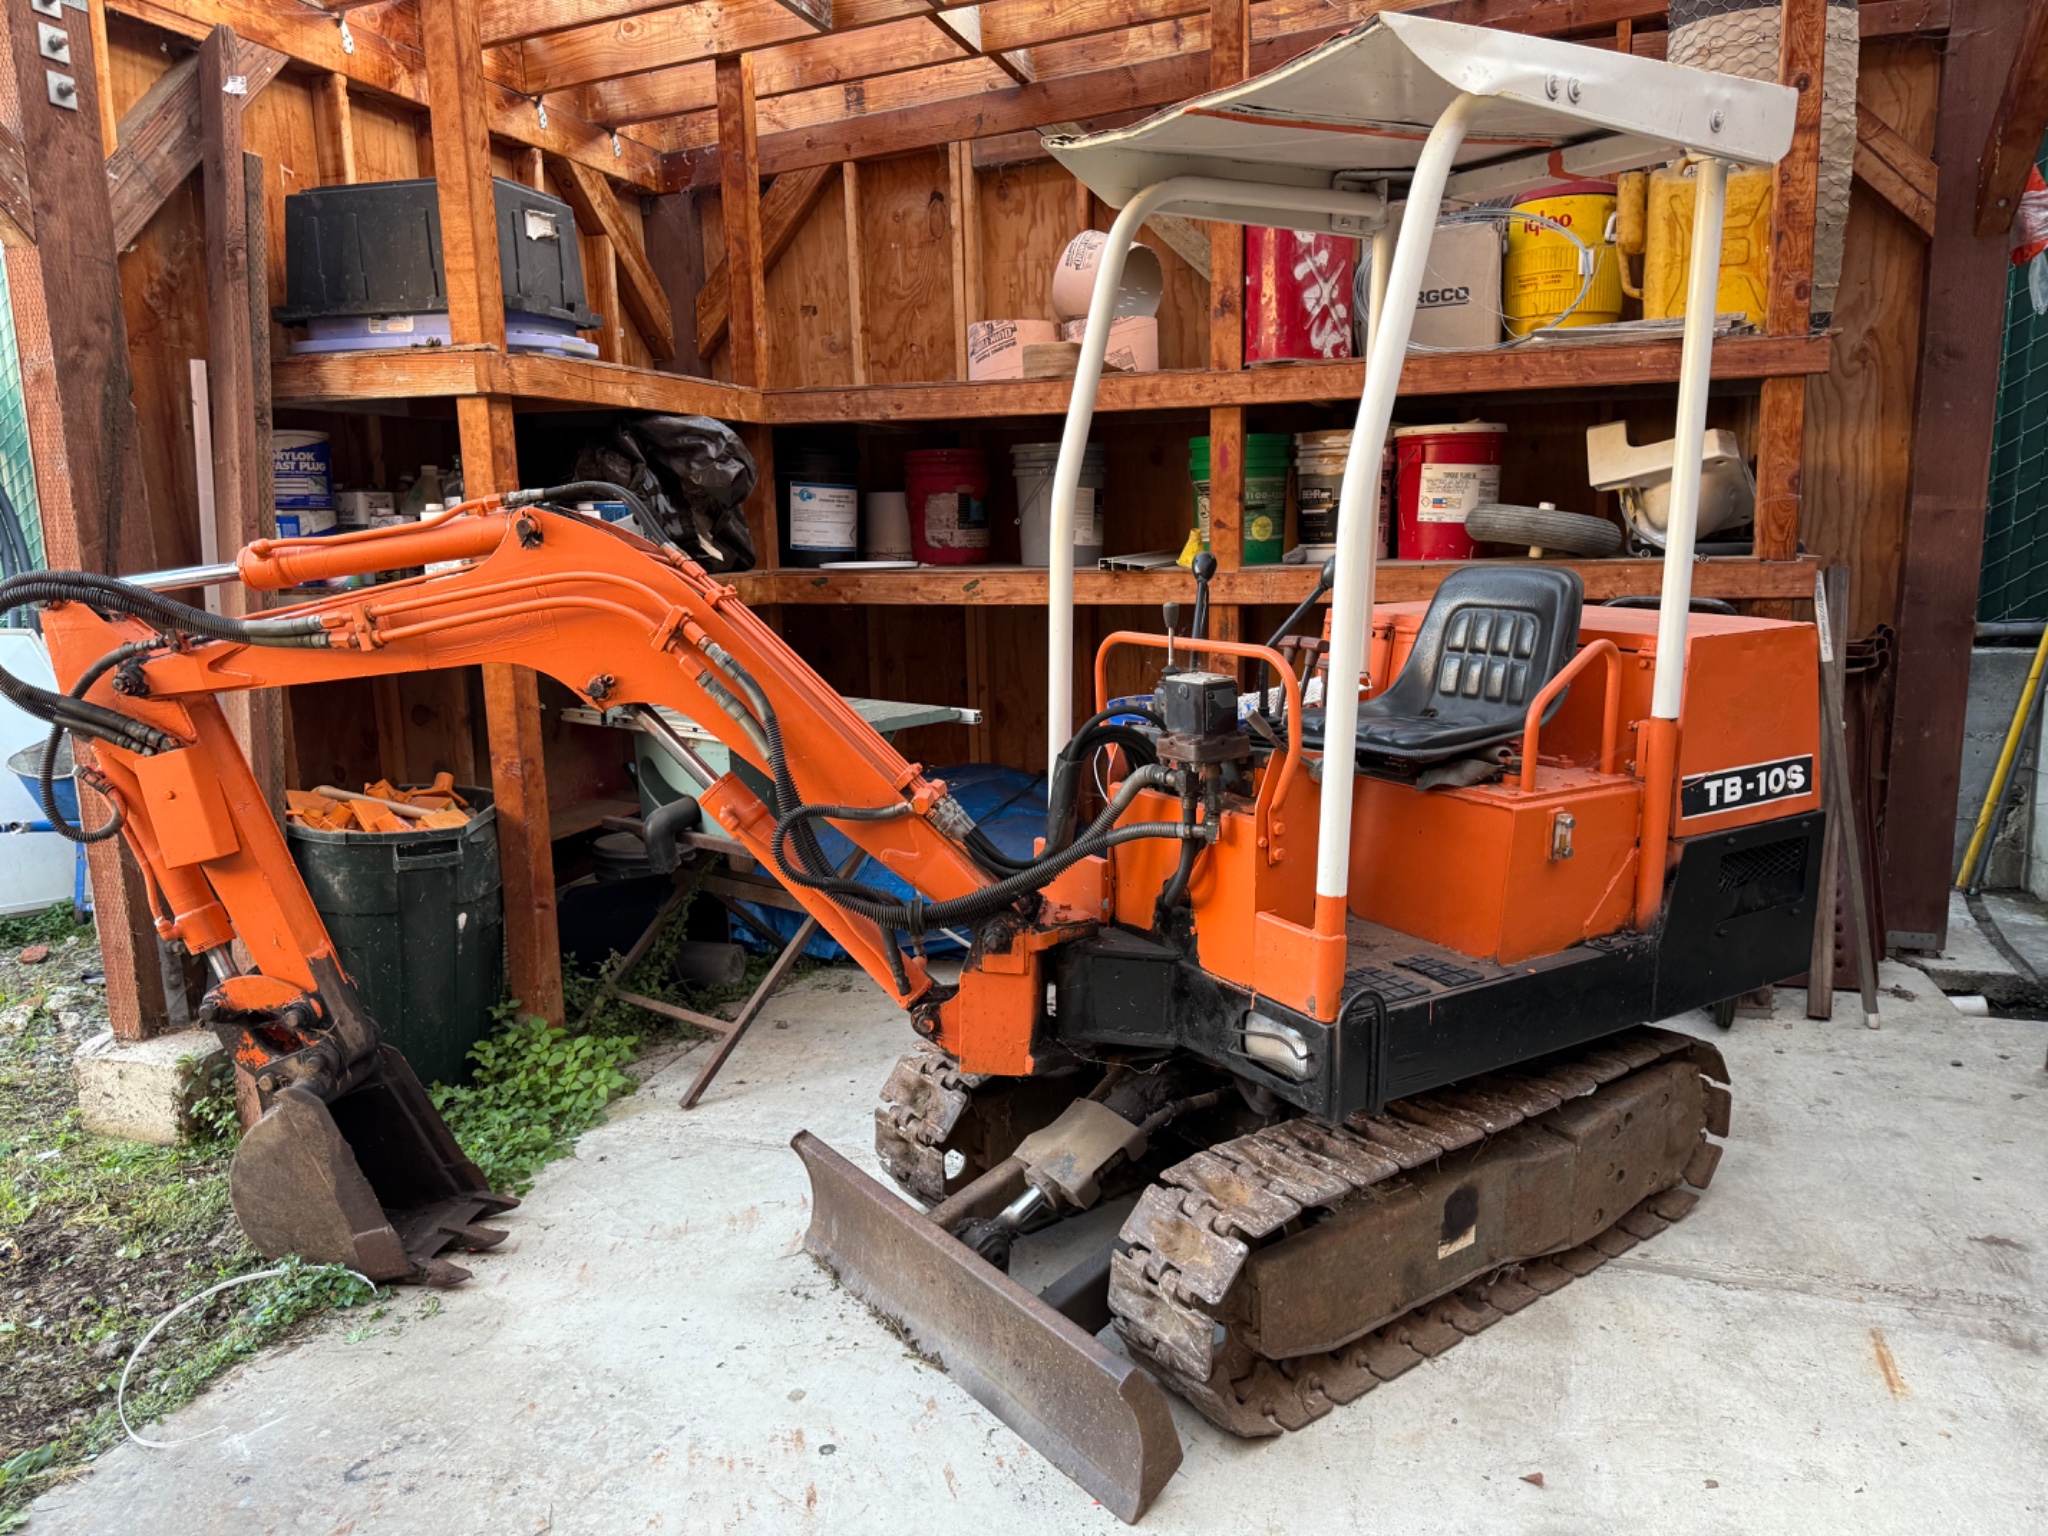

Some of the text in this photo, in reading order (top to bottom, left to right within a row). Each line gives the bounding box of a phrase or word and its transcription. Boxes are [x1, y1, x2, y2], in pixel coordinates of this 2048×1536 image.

[273, 462, 326, 472] AST PLUG
[1704, 764, 1805, 806] TB-10S
